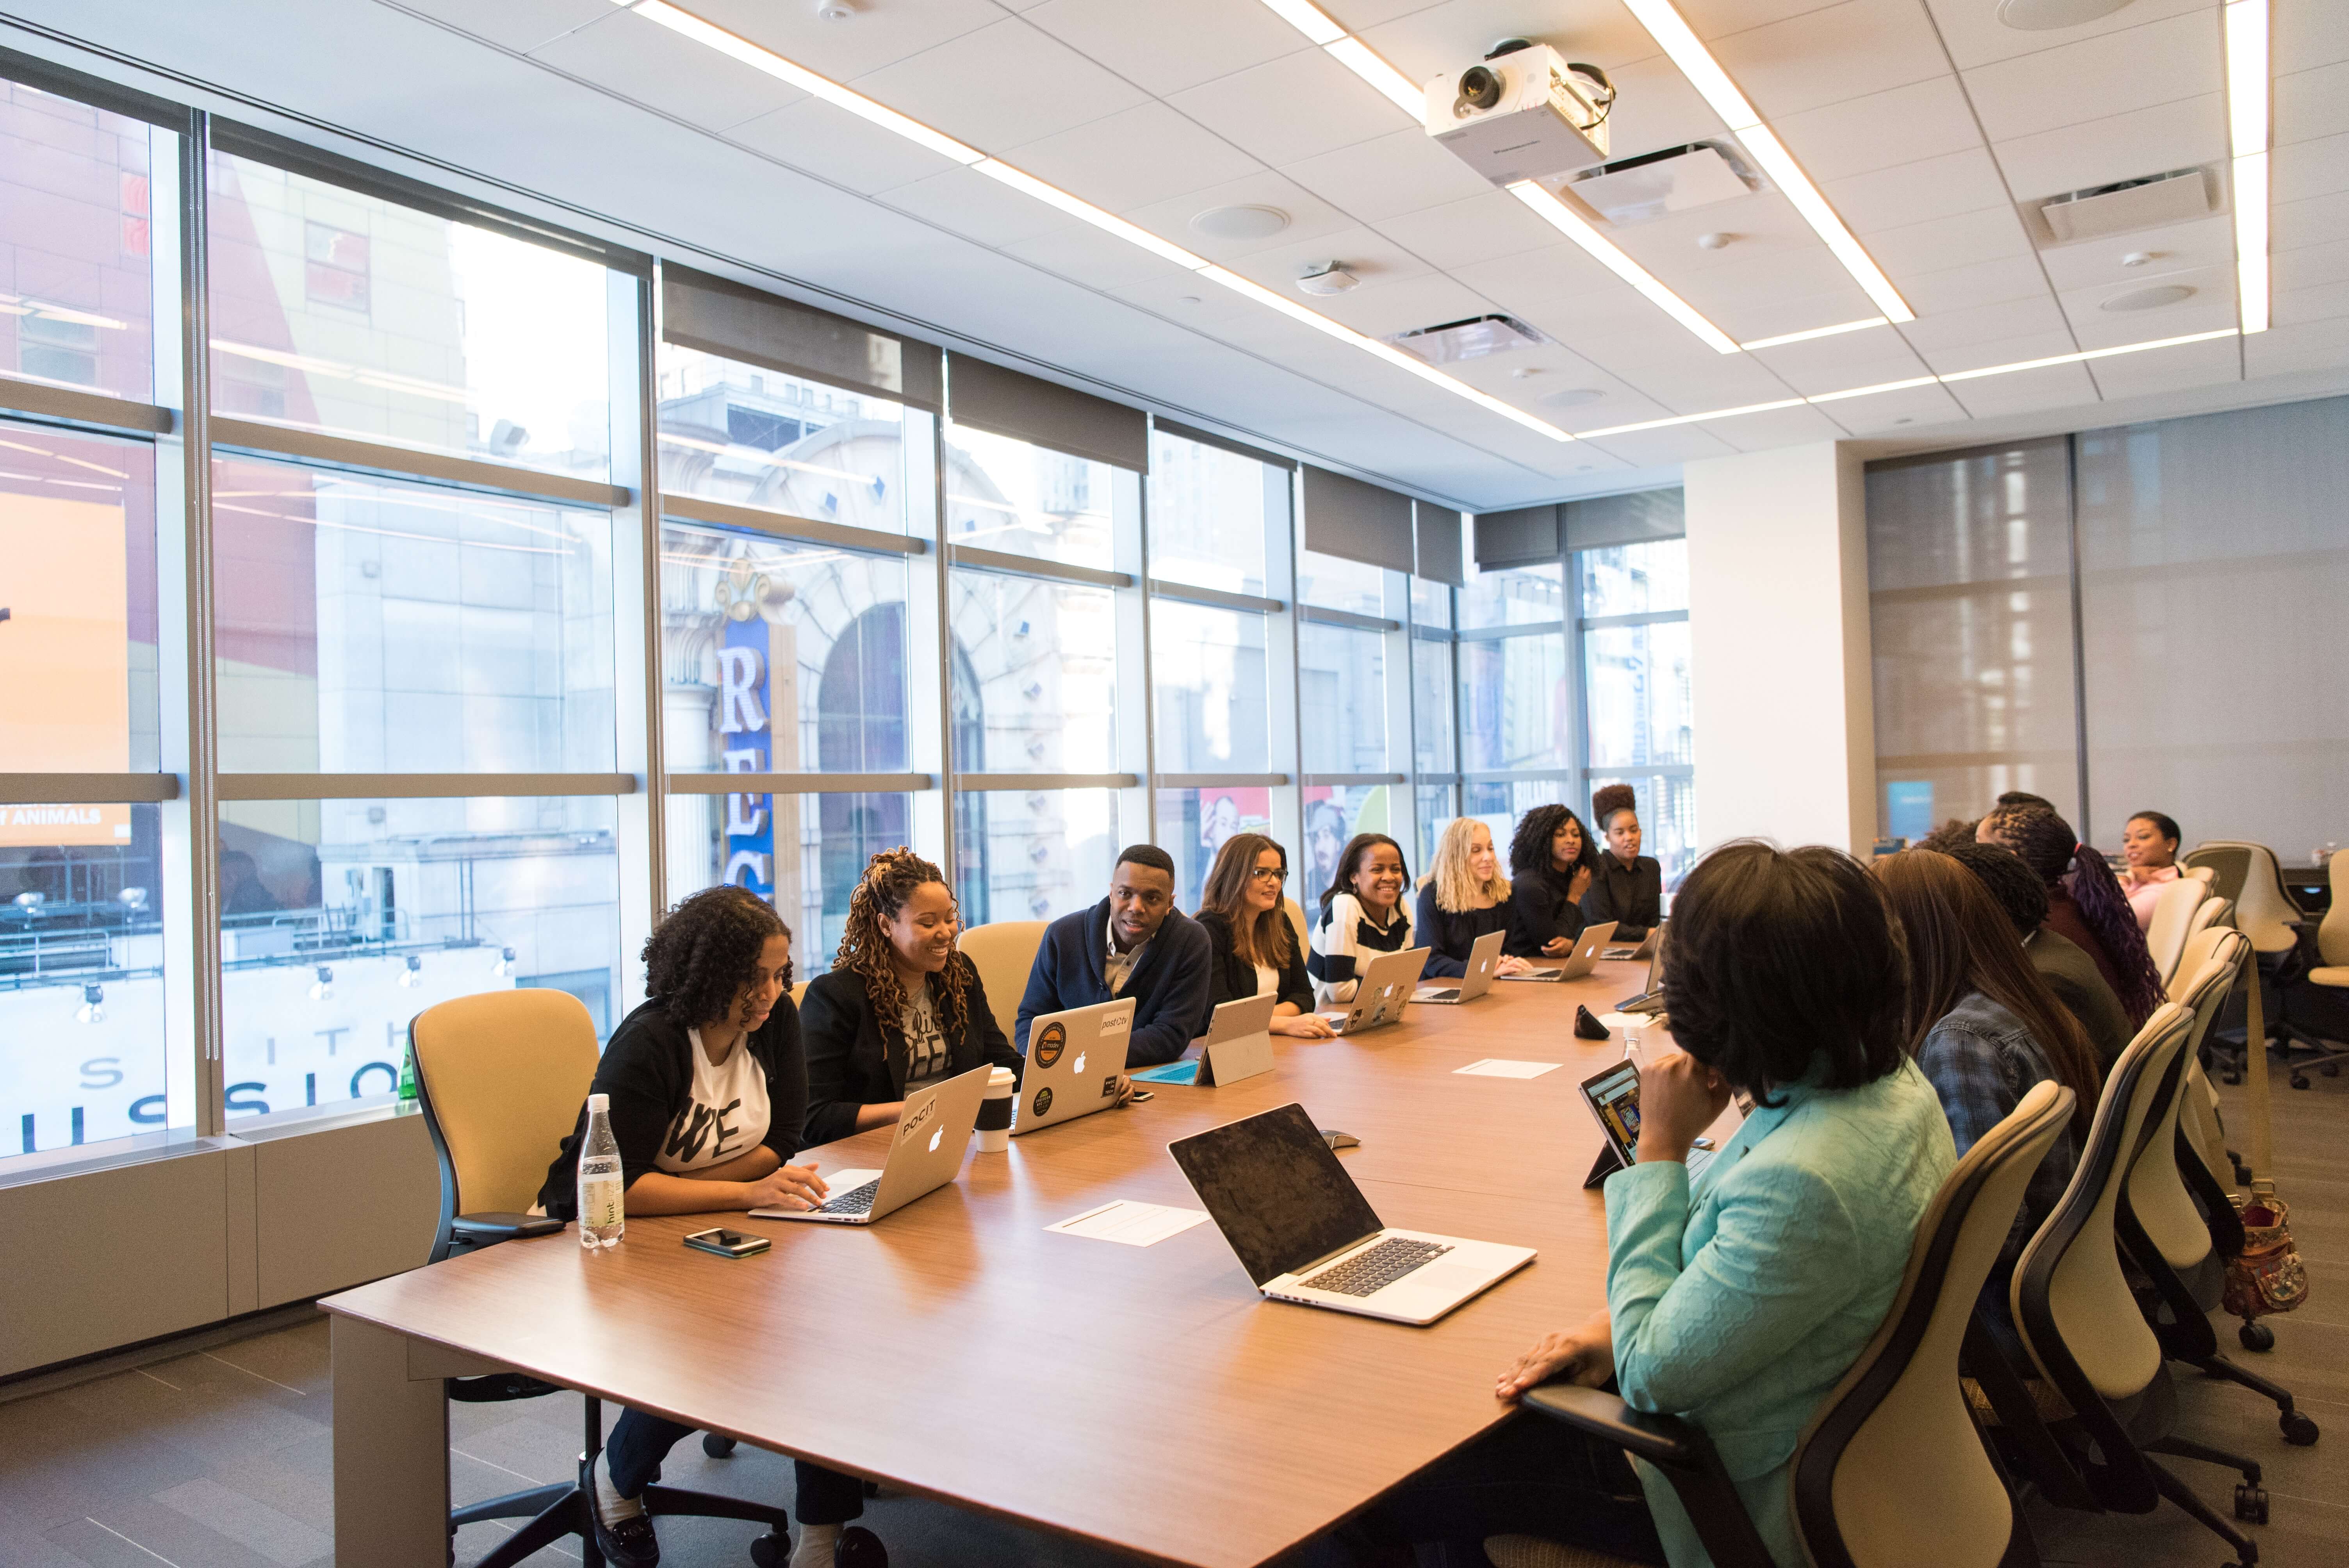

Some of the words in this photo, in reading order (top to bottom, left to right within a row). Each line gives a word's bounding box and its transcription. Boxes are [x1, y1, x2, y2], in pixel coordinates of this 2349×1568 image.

[12, 808, 102, 825] ANIMALS
[665, 1096, 743, 1163] WE
[903, 1099, 936, 1137] POCIT
